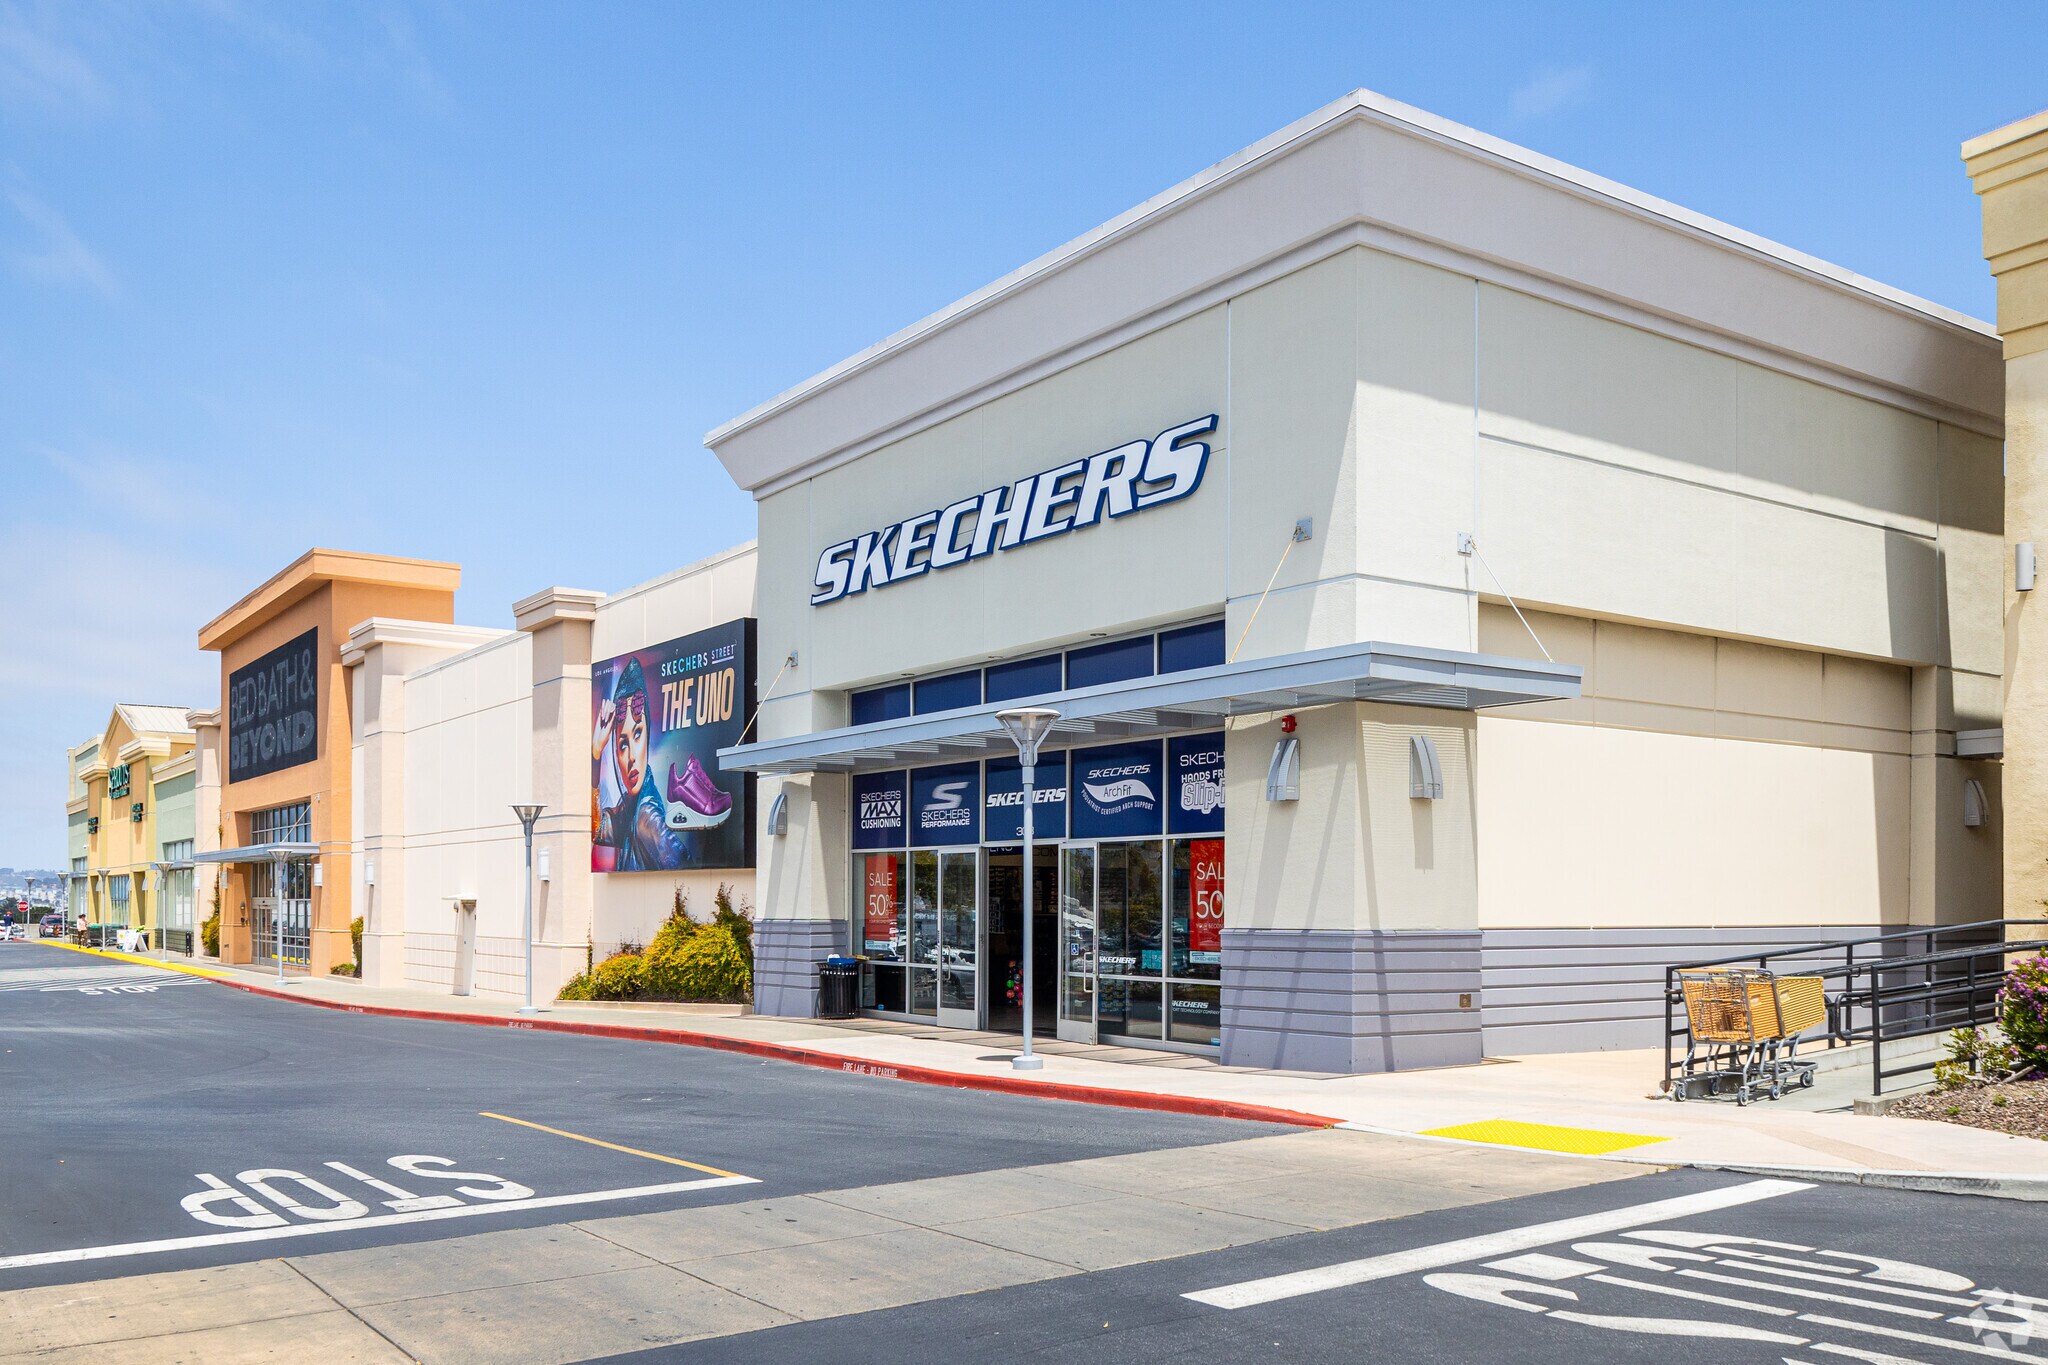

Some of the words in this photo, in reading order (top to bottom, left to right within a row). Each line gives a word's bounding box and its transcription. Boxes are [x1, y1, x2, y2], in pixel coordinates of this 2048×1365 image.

[811, 413, 1220, 606] SKECHERS
[661, 652, 708, 677] SKECHERS
[711, 644, 735, 660] STREET
[231, 677, 257, 729] BED
[258, 654, 298, 718] BATH
[300, 649, 315, 700] &
[661, 677, 694, 733] THE
[696, 667, 735, 726] UNO
[231, 711, 315, 769] BEYOND
[1087, 764, 1151, 779] SKECHERS
[1181, 771, 1211, 783] HANDS
[1212, 768, 1225, 780] FR
[861, 790, 901, 801] SKECHERS
[861, 801, 901, 818] MAX
[921, 808, 970, 822] SKECHERS
[1101, 806, 1122, 815] CERTIFIED
[1122, 802, 1134, 811] ARCH
[1134, 801, 1154, 811] SUPPORT
[861, 818, 901, 830] CUSHIONING
[921, 818, 970, 829] PERFORMANCE
[868, 872, 893, 887] SALE
[78, 985, 159, 996] STOP
[843, 1062, 853, 1072] FIRE
[854, 1064, 866, 1074] LANE
[870, 1066, 877, 1075] NO
[878, 1068, 898, 1078] PARKING
[180, 1154, 536, 1229] STOP
